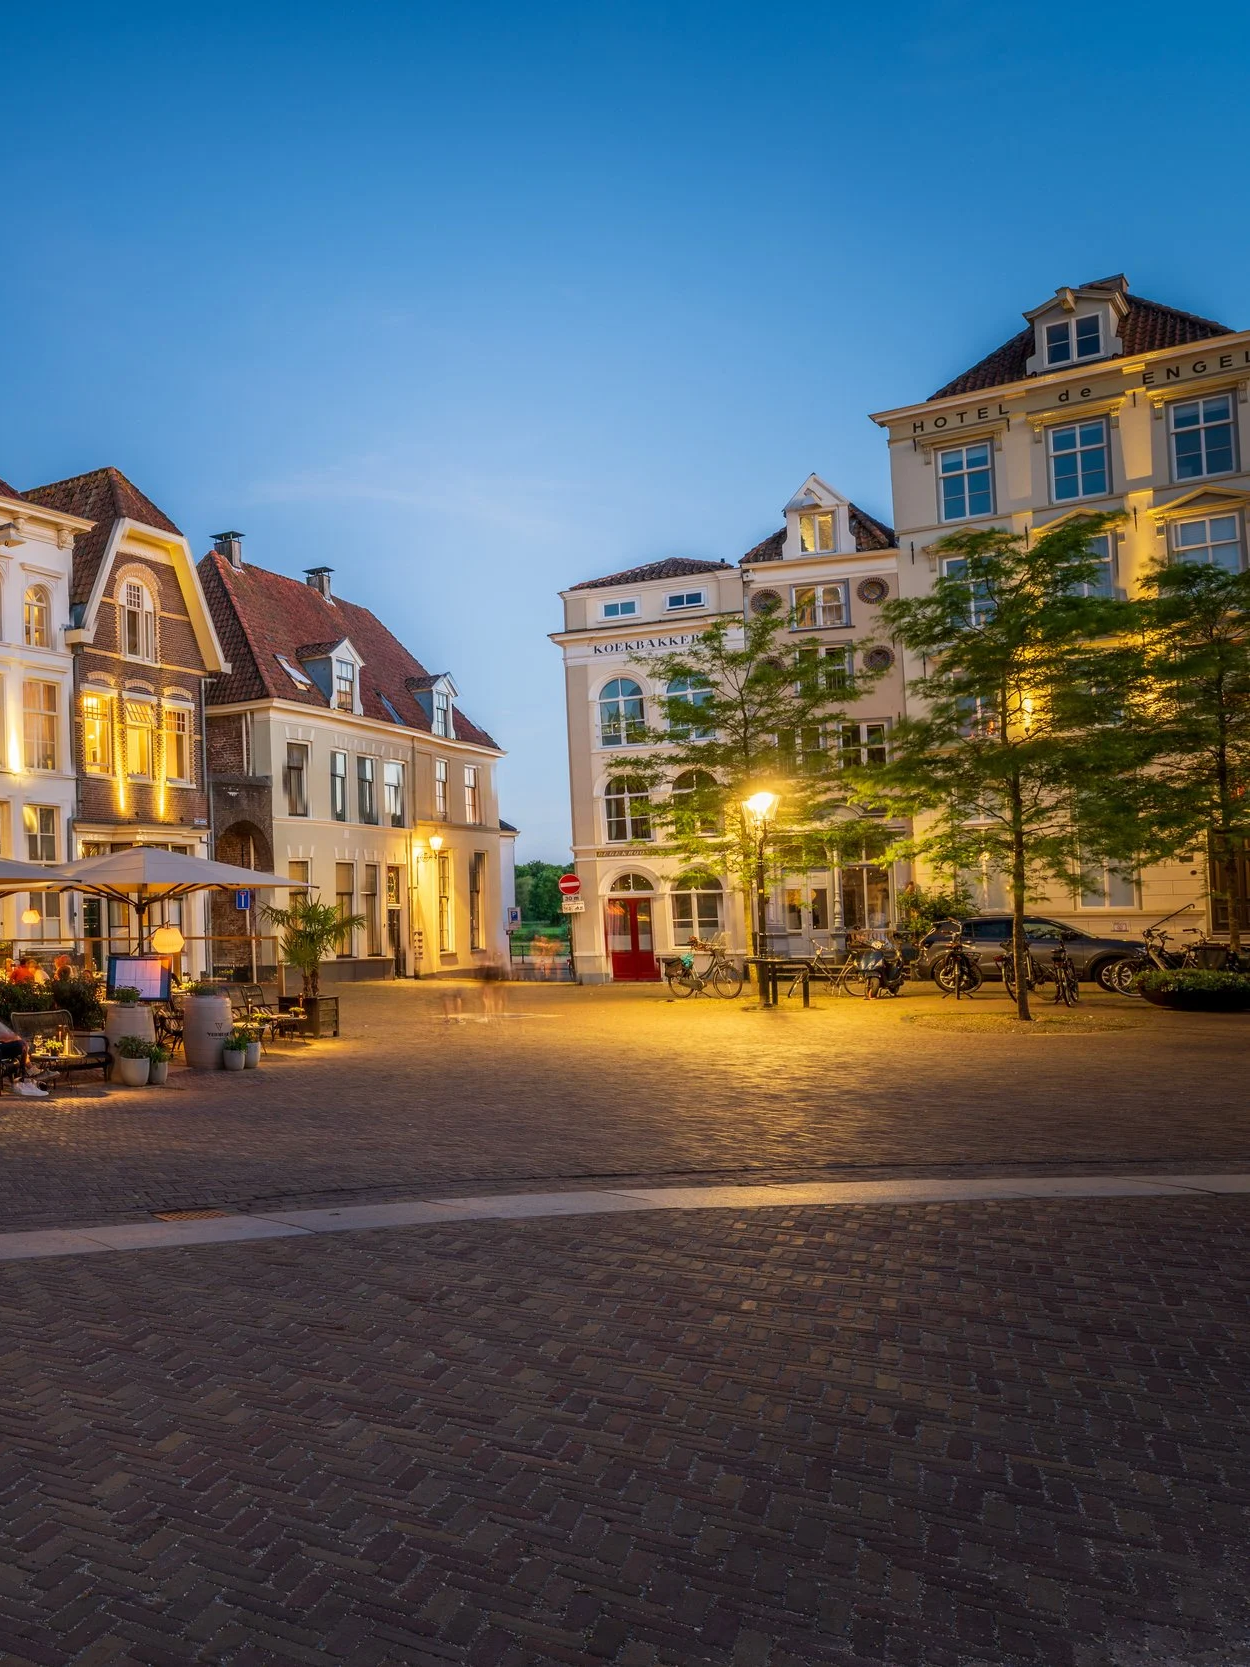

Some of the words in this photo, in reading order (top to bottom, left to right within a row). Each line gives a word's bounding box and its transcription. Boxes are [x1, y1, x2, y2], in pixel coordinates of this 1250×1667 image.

[912, 403, 1010, 434] HOTEL
[1058, 386, 1091, 403] de
[1141, 350, 1250, 385] ENGEL
